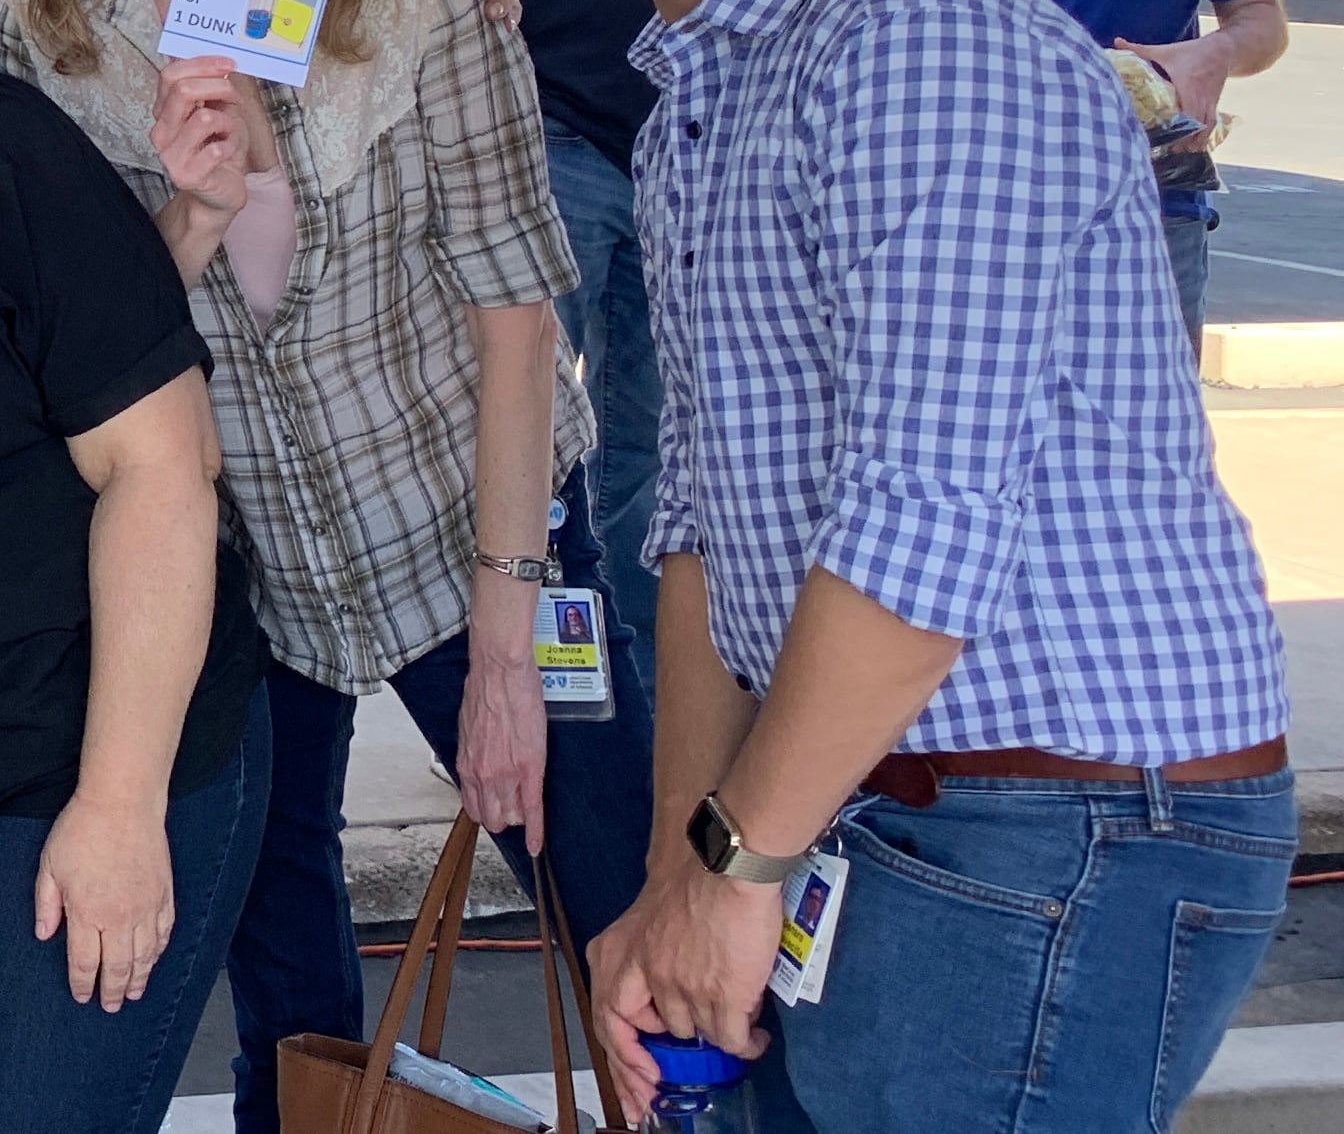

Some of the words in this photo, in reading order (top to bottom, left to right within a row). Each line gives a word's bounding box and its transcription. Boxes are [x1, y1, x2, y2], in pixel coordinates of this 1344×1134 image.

[173, 10, 183, 23] 1
[188, 13, 237, 35] DUNK
[546, 645, 583, 654] Joanna
[546, 656, 586, 665] Stevens
